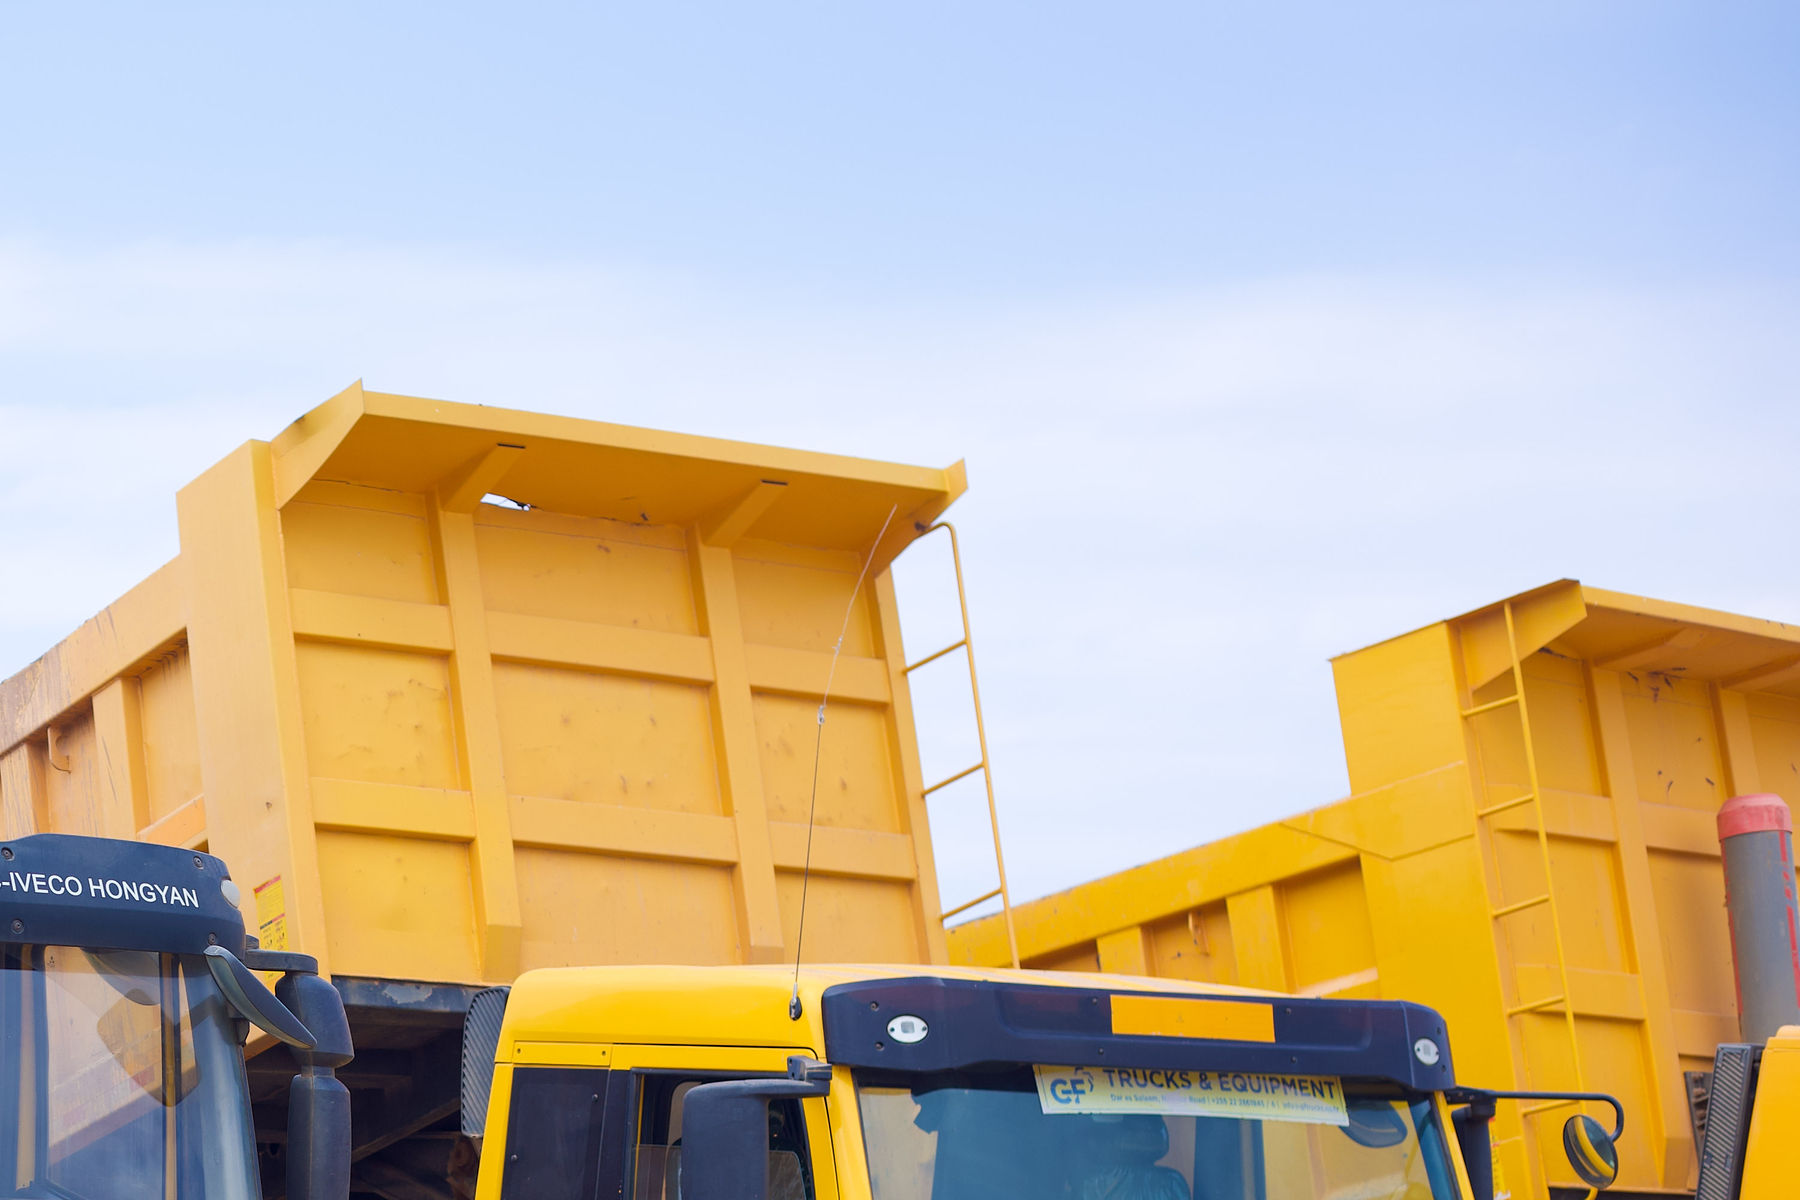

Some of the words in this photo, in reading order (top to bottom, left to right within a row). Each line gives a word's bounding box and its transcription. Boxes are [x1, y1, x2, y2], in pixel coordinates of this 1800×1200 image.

[88, 878, 199, 908] HONGYAN
[1102, 1068, 1193, 1089] TRUCKS
[1199, 1071, 1212, 1091] &
[1217, 1072, 1336, 1099] EQUIPMENT
